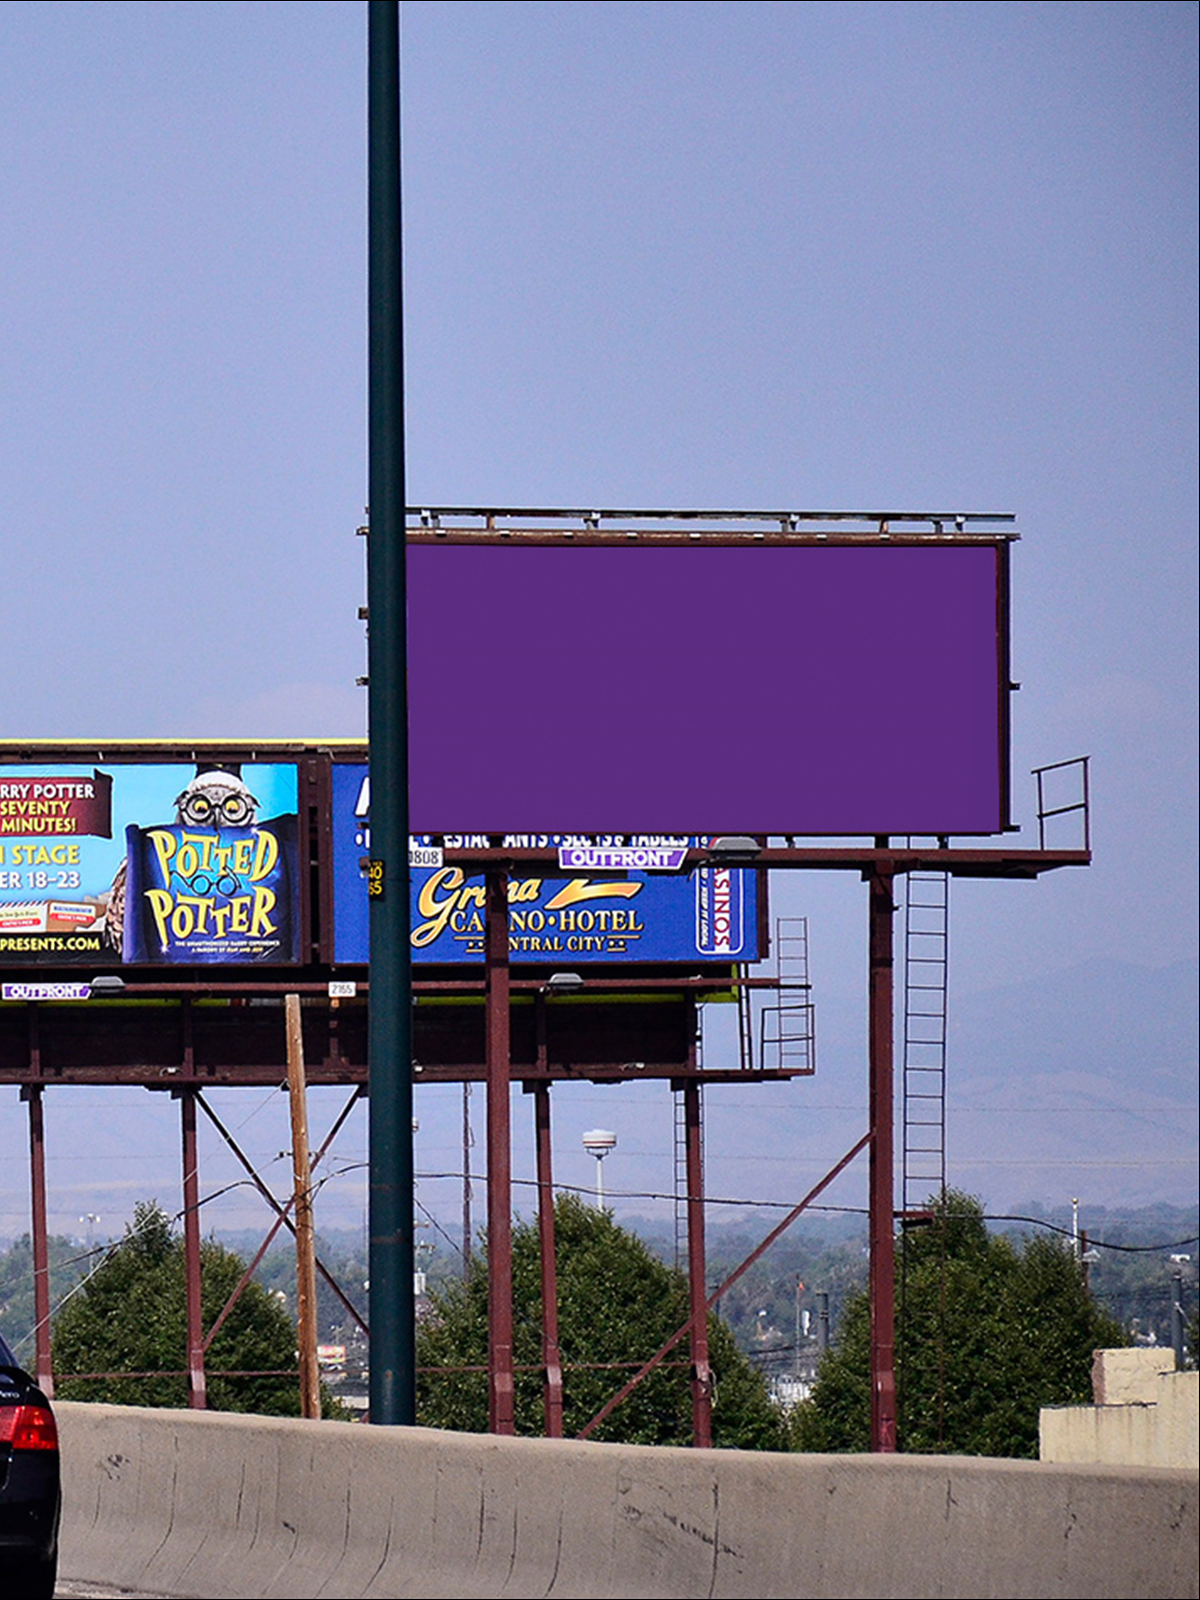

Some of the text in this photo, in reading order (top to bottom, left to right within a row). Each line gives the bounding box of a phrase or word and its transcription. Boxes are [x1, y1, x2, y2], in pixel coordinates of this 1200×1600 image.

[34, 784, 95, 799] POTTER
[0, 801, 70, 815] SEVENTY
[1, 817, 76, 832] MINUTES!
[12, 845, 80, 865] STAGE
[146, 829, 278, 889] POTTED
[571, 851, 674, 866] OUTFRONT
[143, 886, 278, 946] POTTER
[450, 910, 644, 932] CANO HOTEL
[508, 935, 605, 951] NTRAL CITY
[11, 986, 80, 998] OUTFRONT
